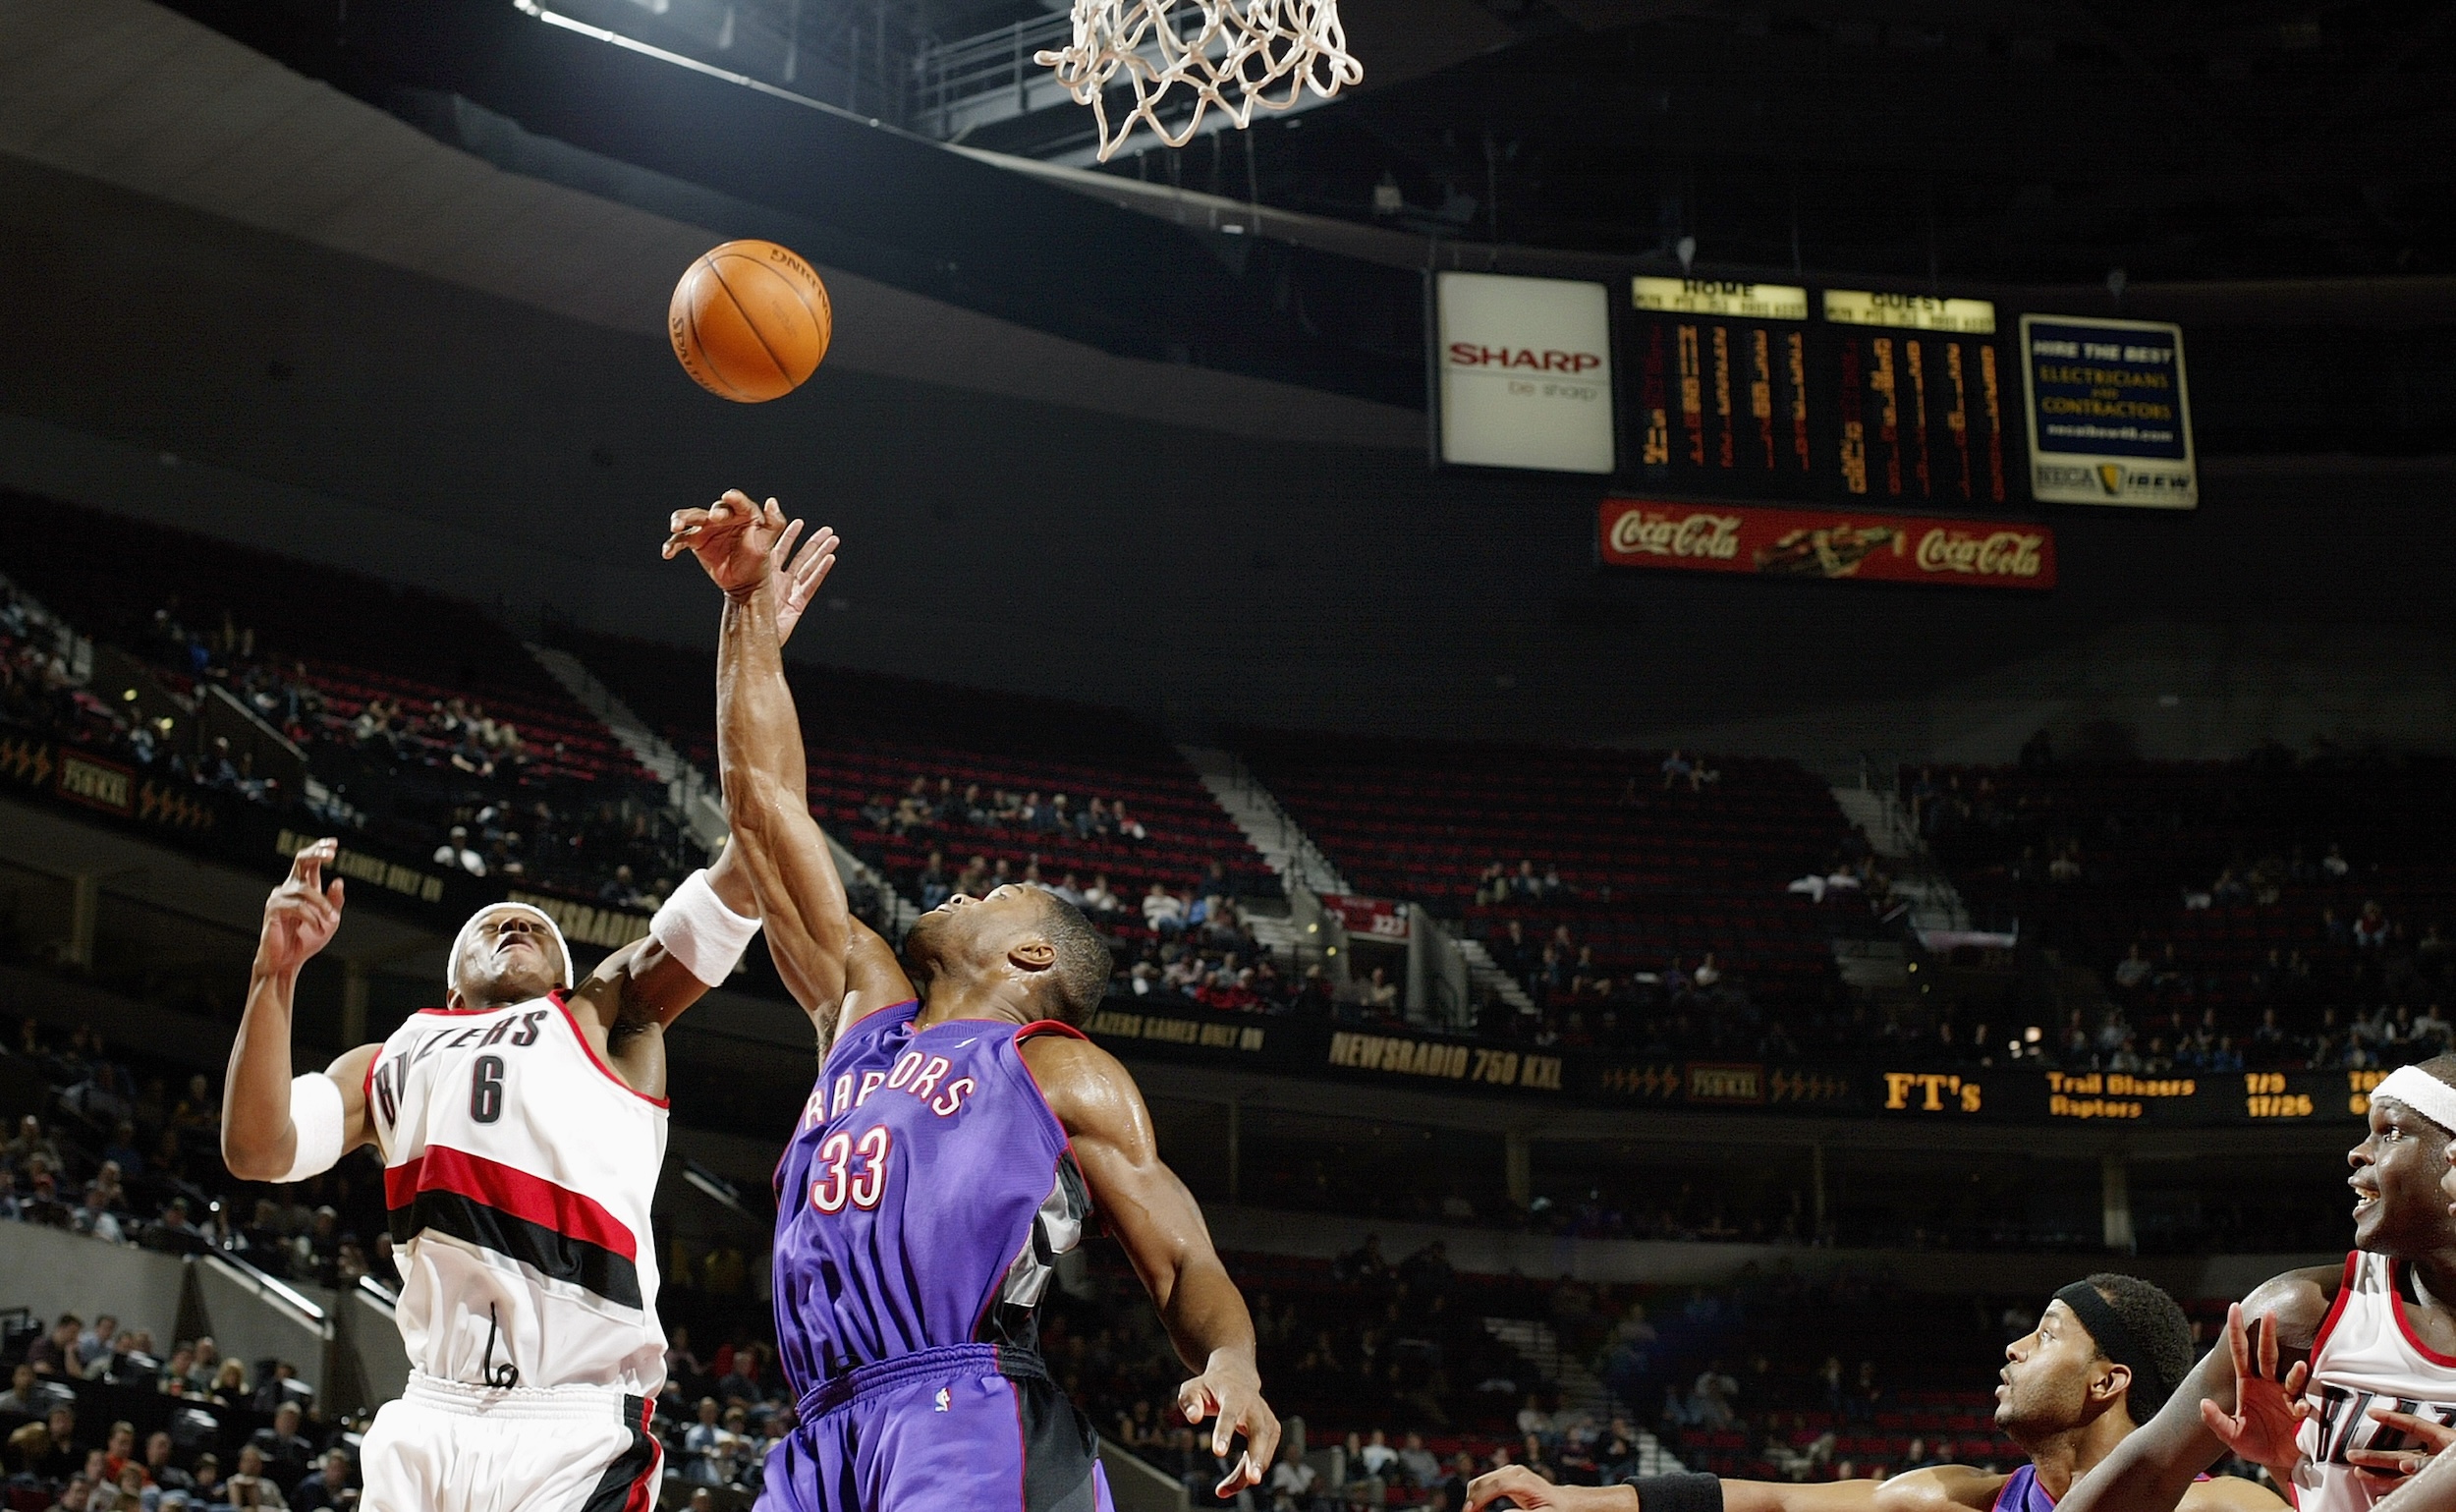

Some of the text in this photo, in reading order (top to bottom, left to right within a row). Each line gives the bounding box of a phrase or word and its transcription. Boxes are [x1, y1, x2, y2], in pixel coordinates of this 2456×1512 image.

[1683, 280, 1755, 298] HOME
[1871, 293, 1948, 312] GUEST
[1449, 342, 1601, 374] SHARP
[2124, 345, 2173, 364] BEST
[2041, 396, 2172, 421] CONTRACTORS
[1328, 1031, 1564, 1092] NEWSRADIO 750 KXL
[468, 1053, 508, 1127] 6
[802, 1050, 976, 1132] RAPORS
[1883, 1072, 1982, 1113] FT's
[2045, 1070, 2103, 1095] Trail
[2106, 1073, 2197, 1097] Blazers
[2048, 1093, 2144, 1119] Raptors
[809, 1125, 892, 1215] 33
